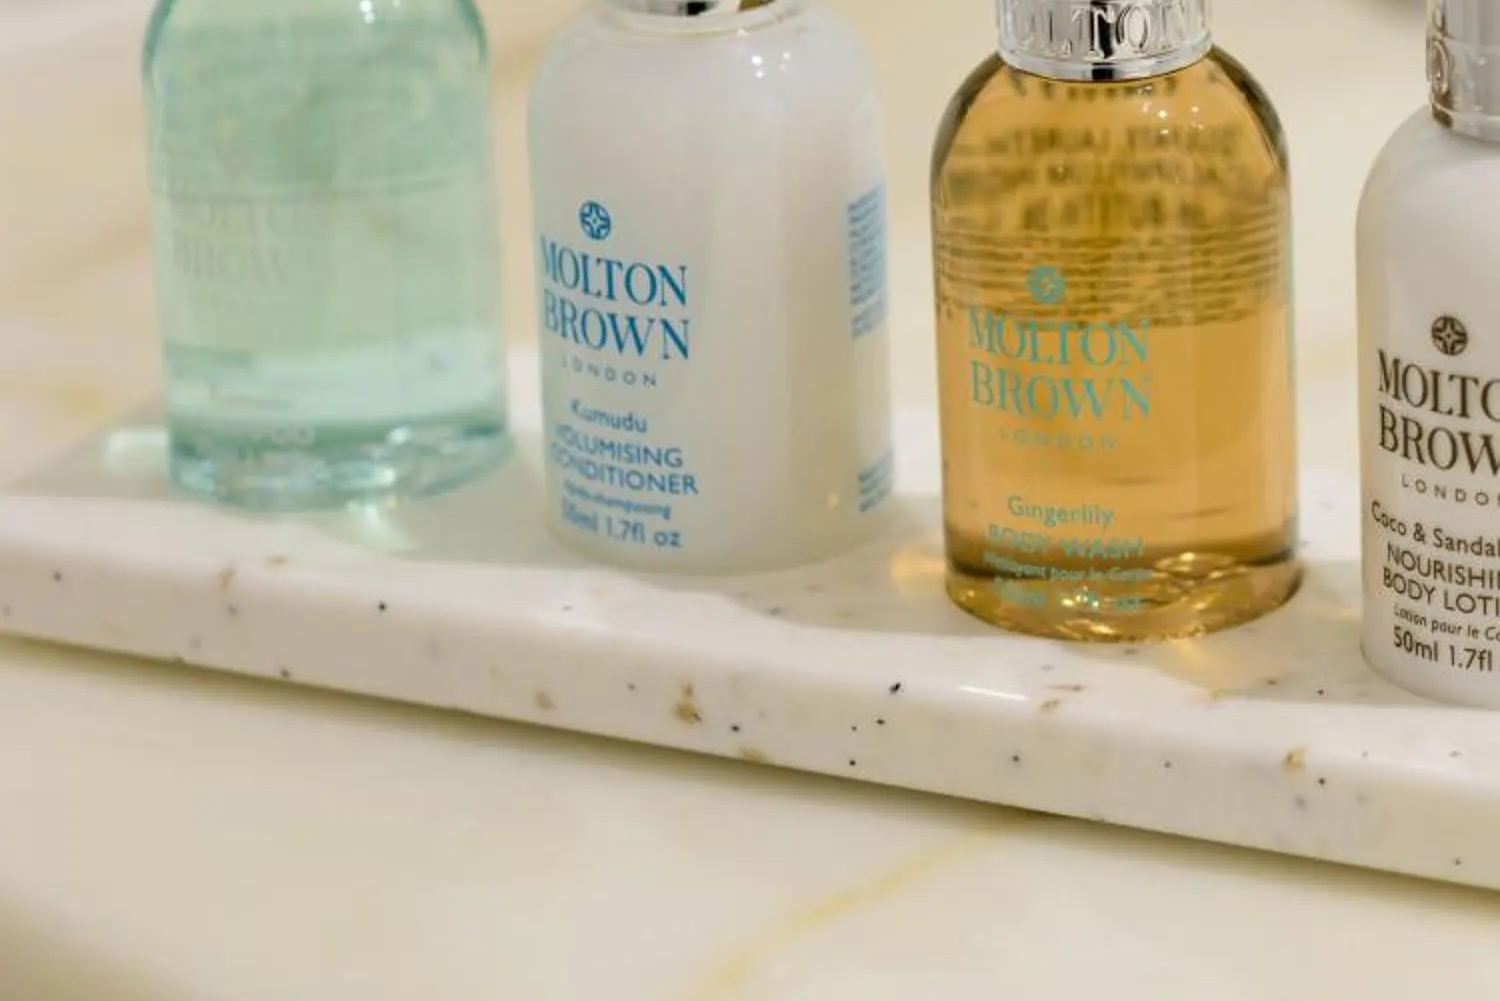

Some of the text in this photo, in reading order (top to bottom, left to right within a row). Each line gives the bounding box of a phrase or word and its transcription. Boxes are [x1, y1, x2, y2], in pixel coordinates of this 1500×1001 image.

[540, 235, 688, 308] MOLTON
[544, 288, 690, 360] BROWN
[969, 306, 1150, 366] MOLTON
[970, 359, 1150, 421] BROWN
[1007, 495, 1115, 529] Gingerlily
[1371, 500, 1407, 536] Coco
[1413, 522, 1426, 544] &
[653, 530, 682, 547] oz
[1382, 567, 1436, 604] BODY
[1393, 625, 1439, 662] 50ml
[1449, 645, 1493, 672] 1.7fl
[1431, 619, 1463, 636] pour
[1467, 625, 1479, 639] le
